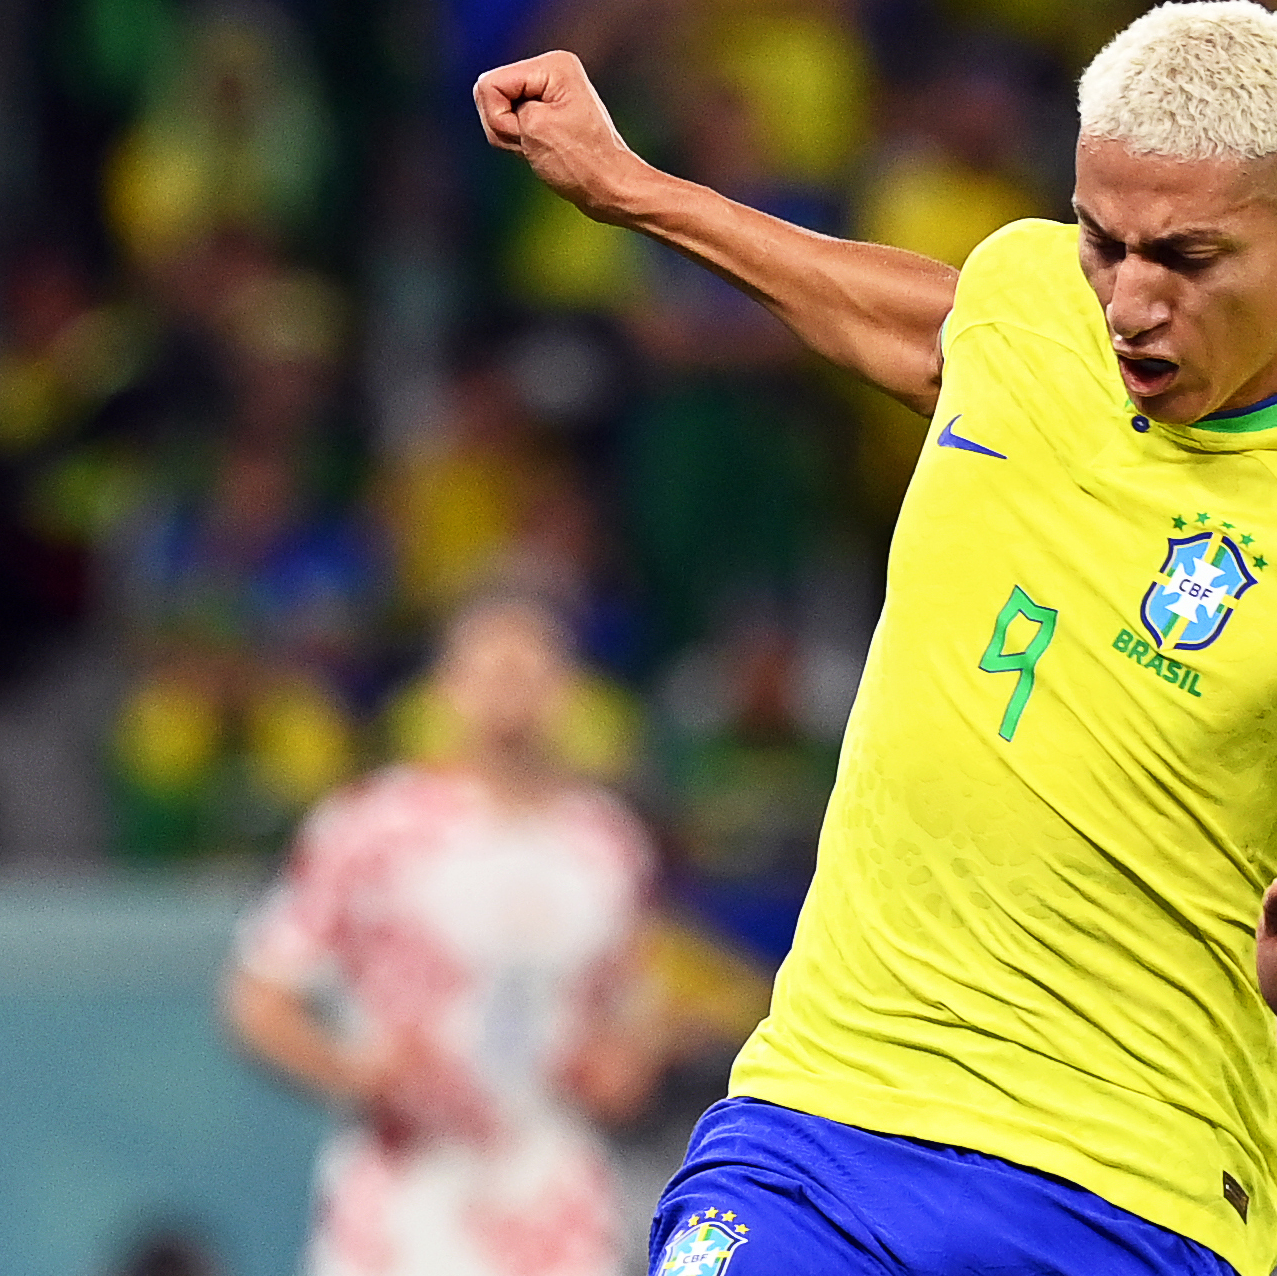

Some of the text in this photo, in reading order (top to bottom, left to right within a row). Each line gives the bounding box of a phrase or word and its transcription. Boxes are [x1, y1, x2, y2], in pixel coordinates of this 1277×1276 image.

[1179, 578, 1213, 600] CBF
[978, 584, 1059, 742] 9
[1112, 627, 1202, 698] BRASIL
[682, 1253, 709, 1265] CBF
